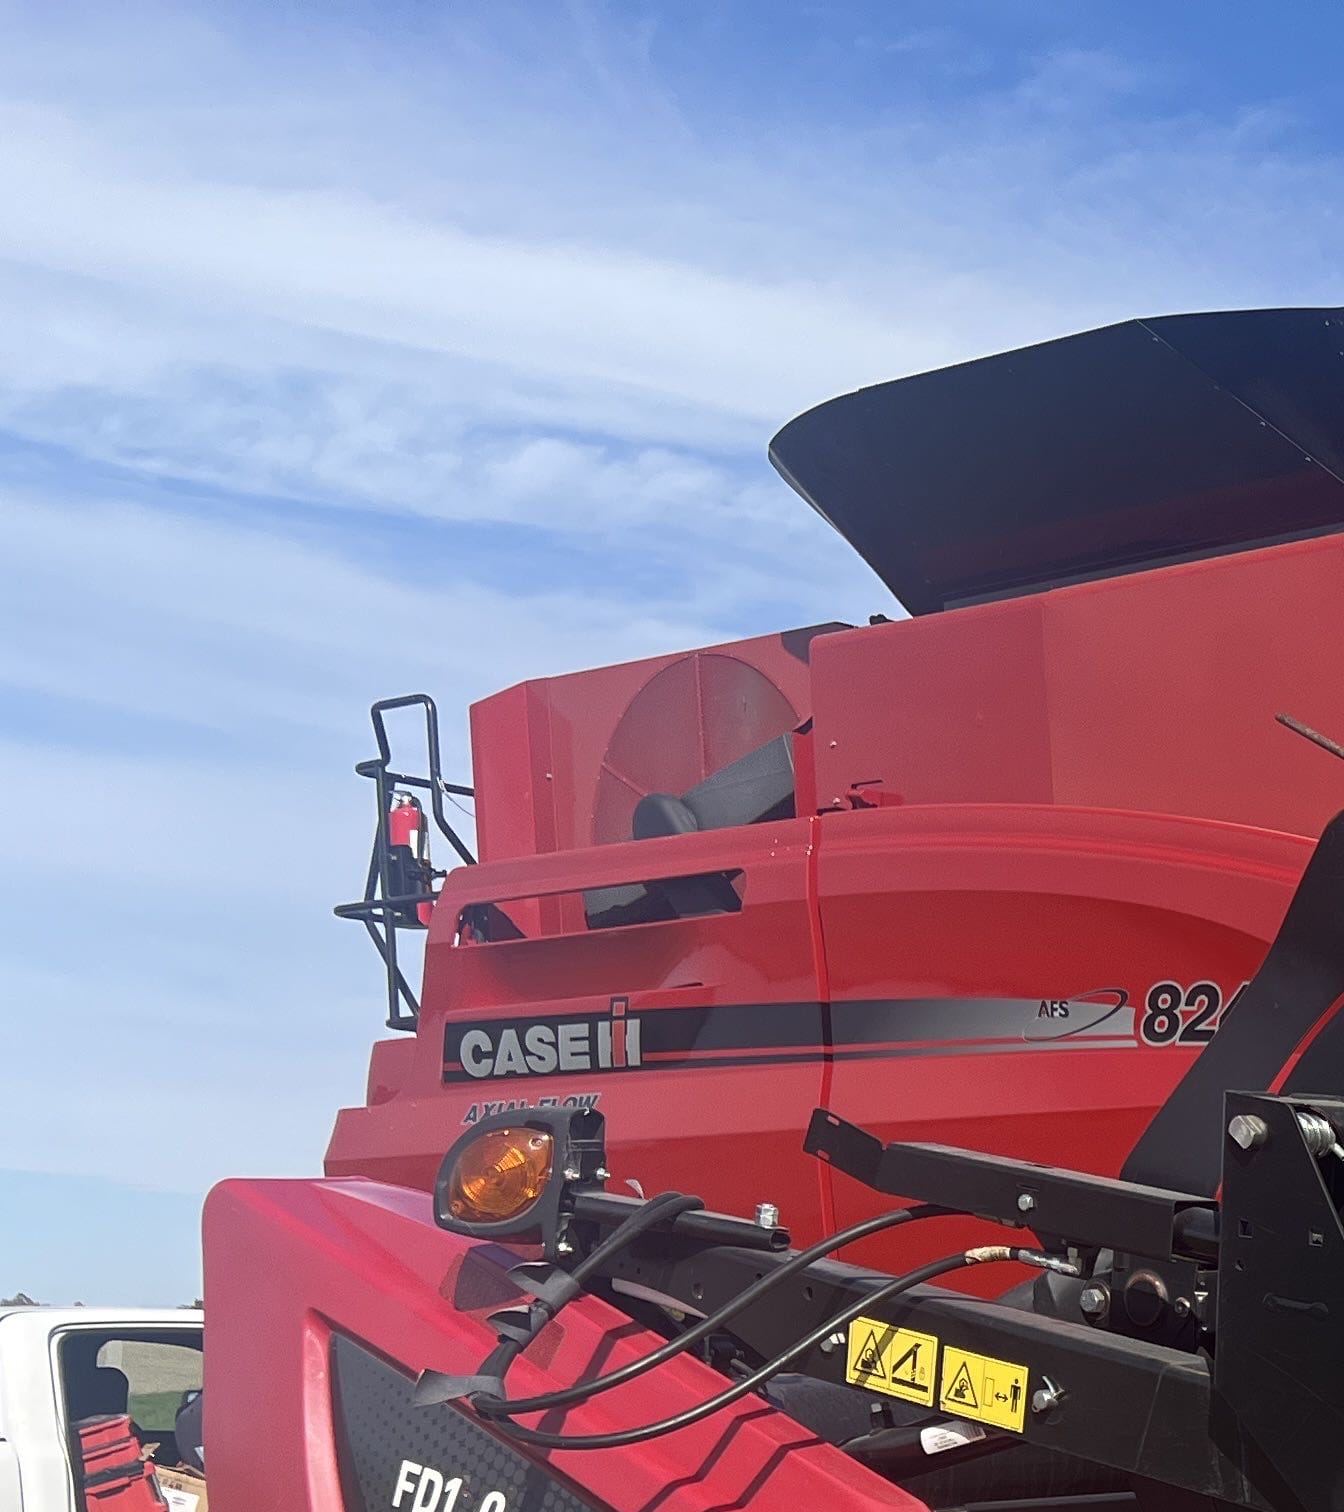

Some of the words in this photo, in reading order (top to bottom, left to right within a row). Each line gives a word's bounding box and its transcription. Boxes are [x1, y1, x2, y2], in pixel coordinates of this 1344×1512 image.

[1037, 999, 1070, 1018] AFS
[1141, 980, 1250, 1047] 82
[459, 1024, 592, 1078] CASE
